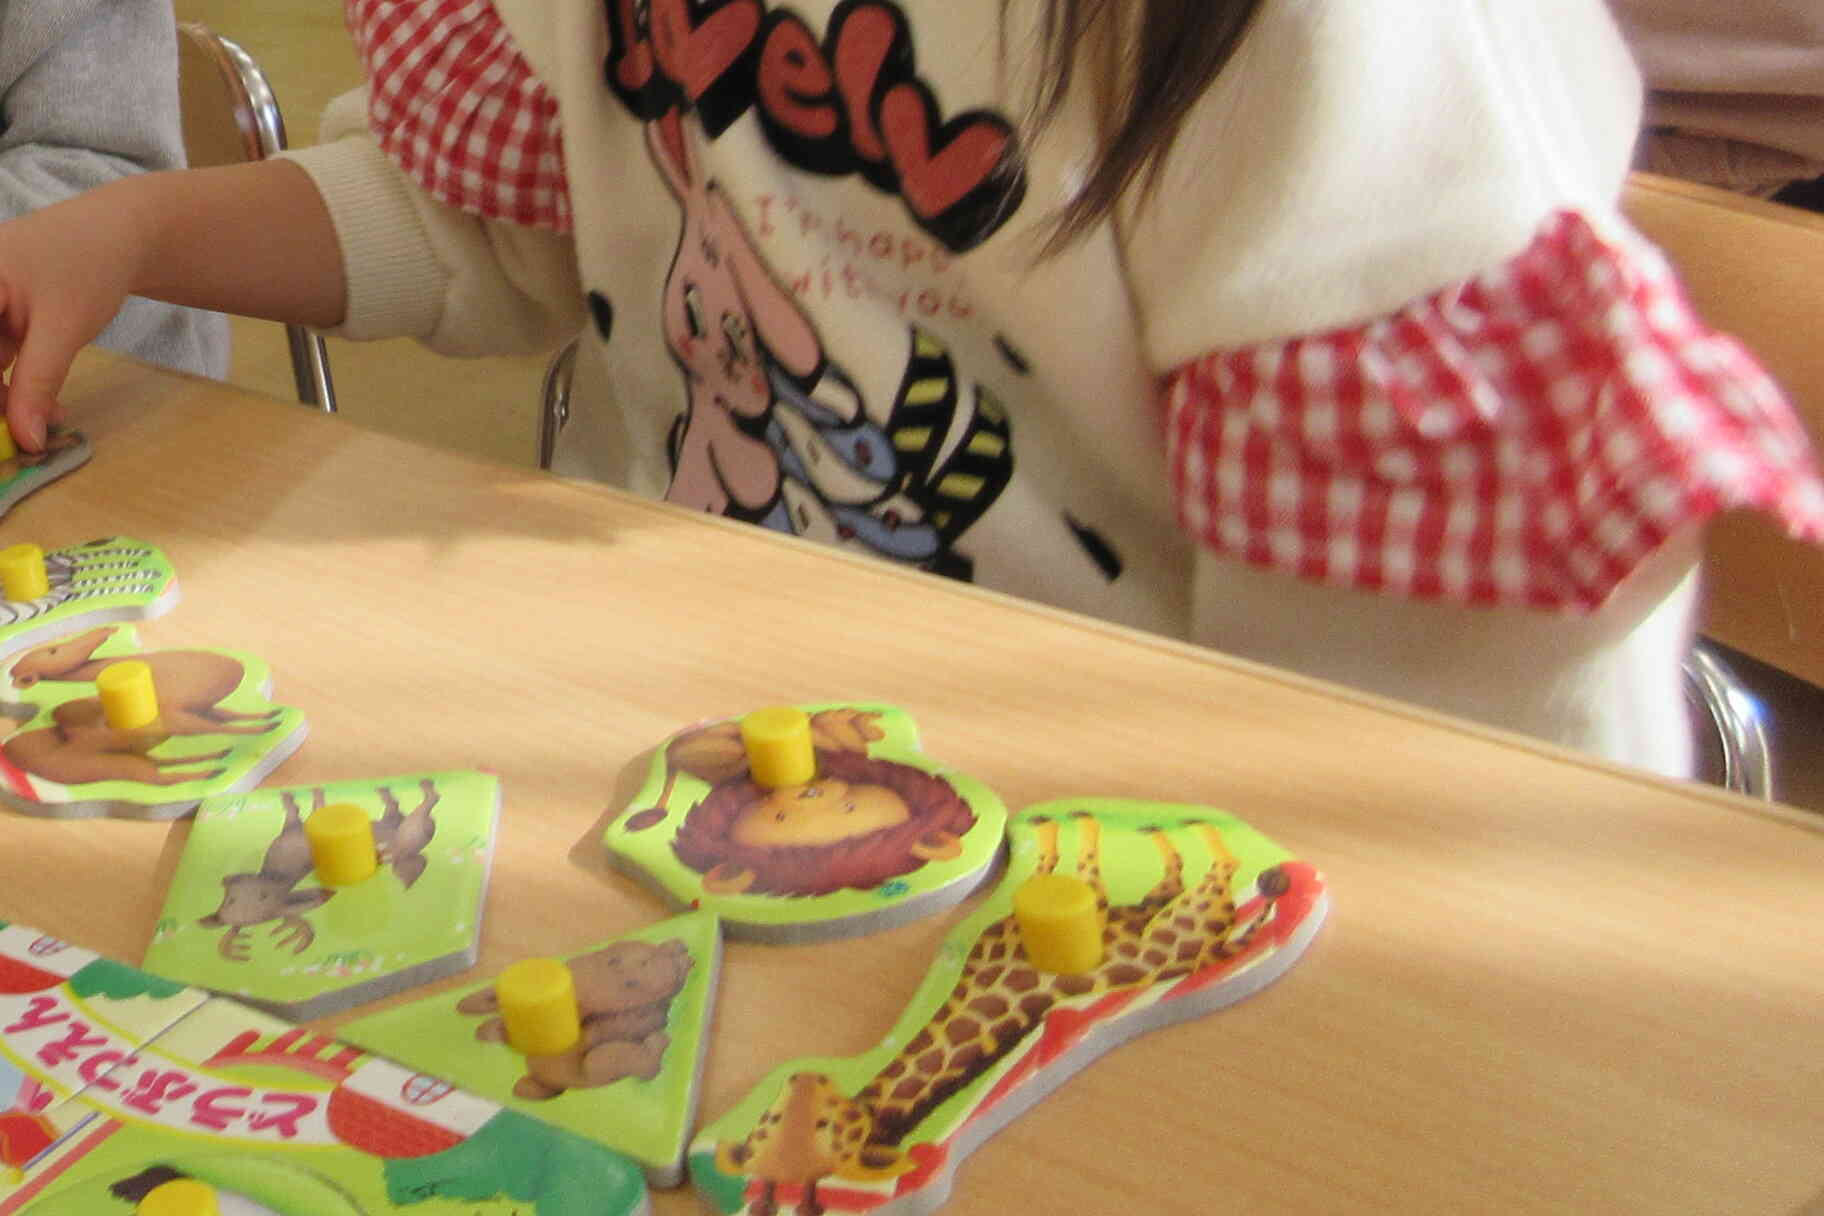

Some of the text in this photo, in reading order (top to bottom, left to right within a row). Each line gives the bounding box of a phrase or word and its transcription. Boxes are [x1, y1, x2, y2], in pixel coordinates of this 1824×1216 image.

[3, 996, 319, 1139] どうぶつえん
